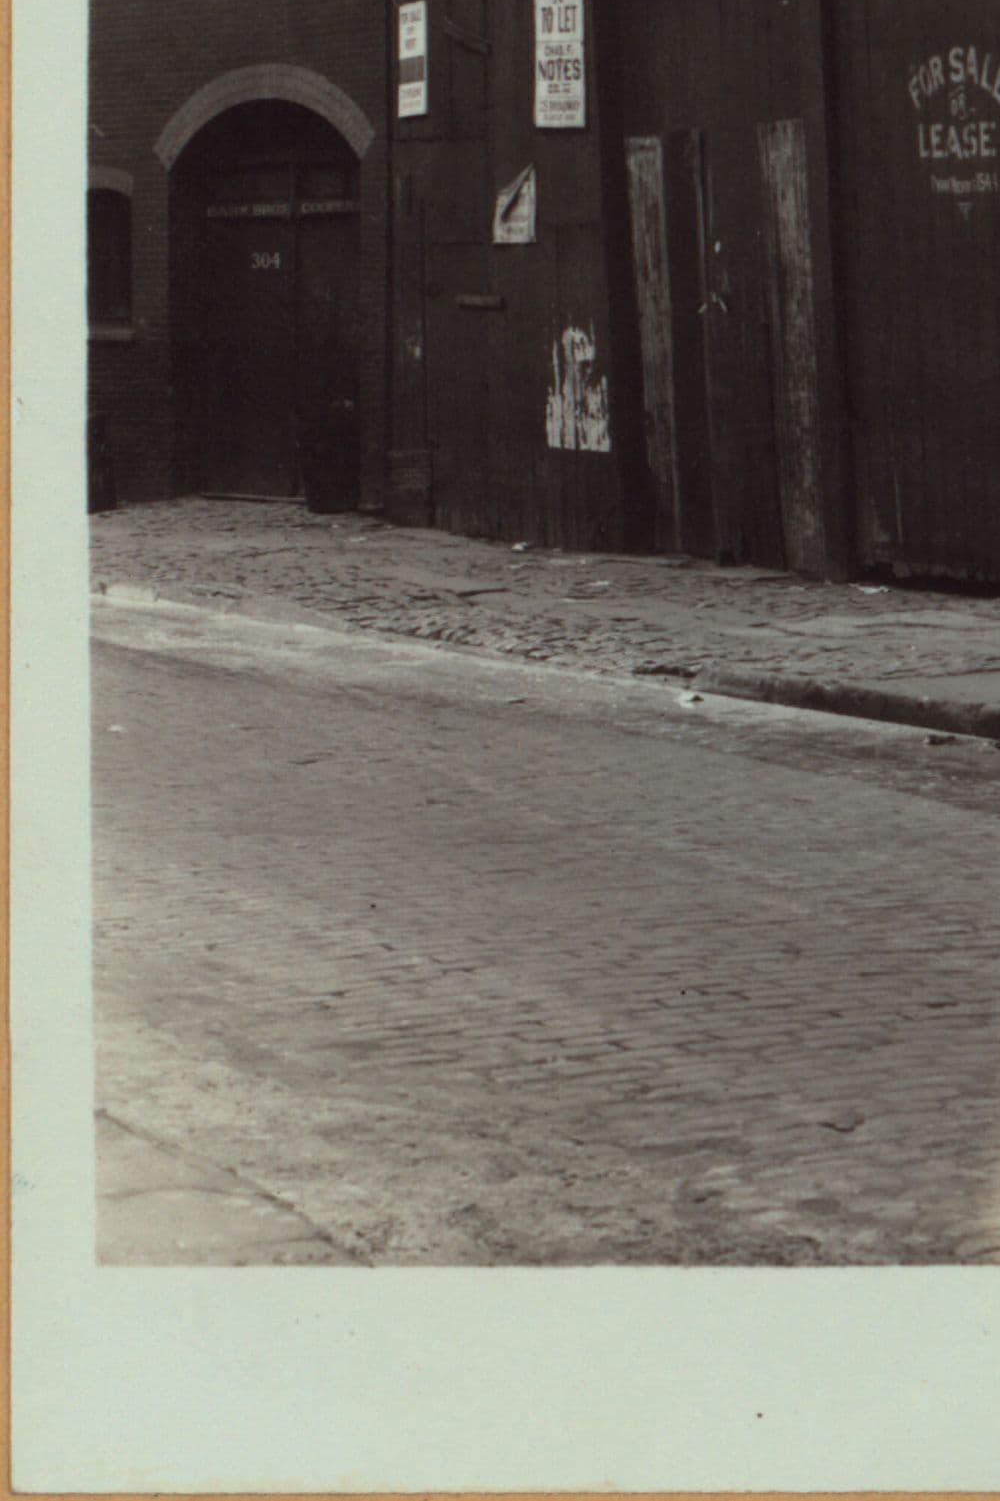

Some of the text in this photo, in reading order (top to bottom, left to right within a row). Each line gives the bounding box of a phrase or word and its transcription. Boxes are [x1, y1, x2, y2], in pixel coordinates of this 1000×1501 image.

[541, 5, 577, 33] TO LET
[908, 55, 945, 109] FOR
[917, 122, 996, 159] LEASE
[250, 252, 281, 268] 304
